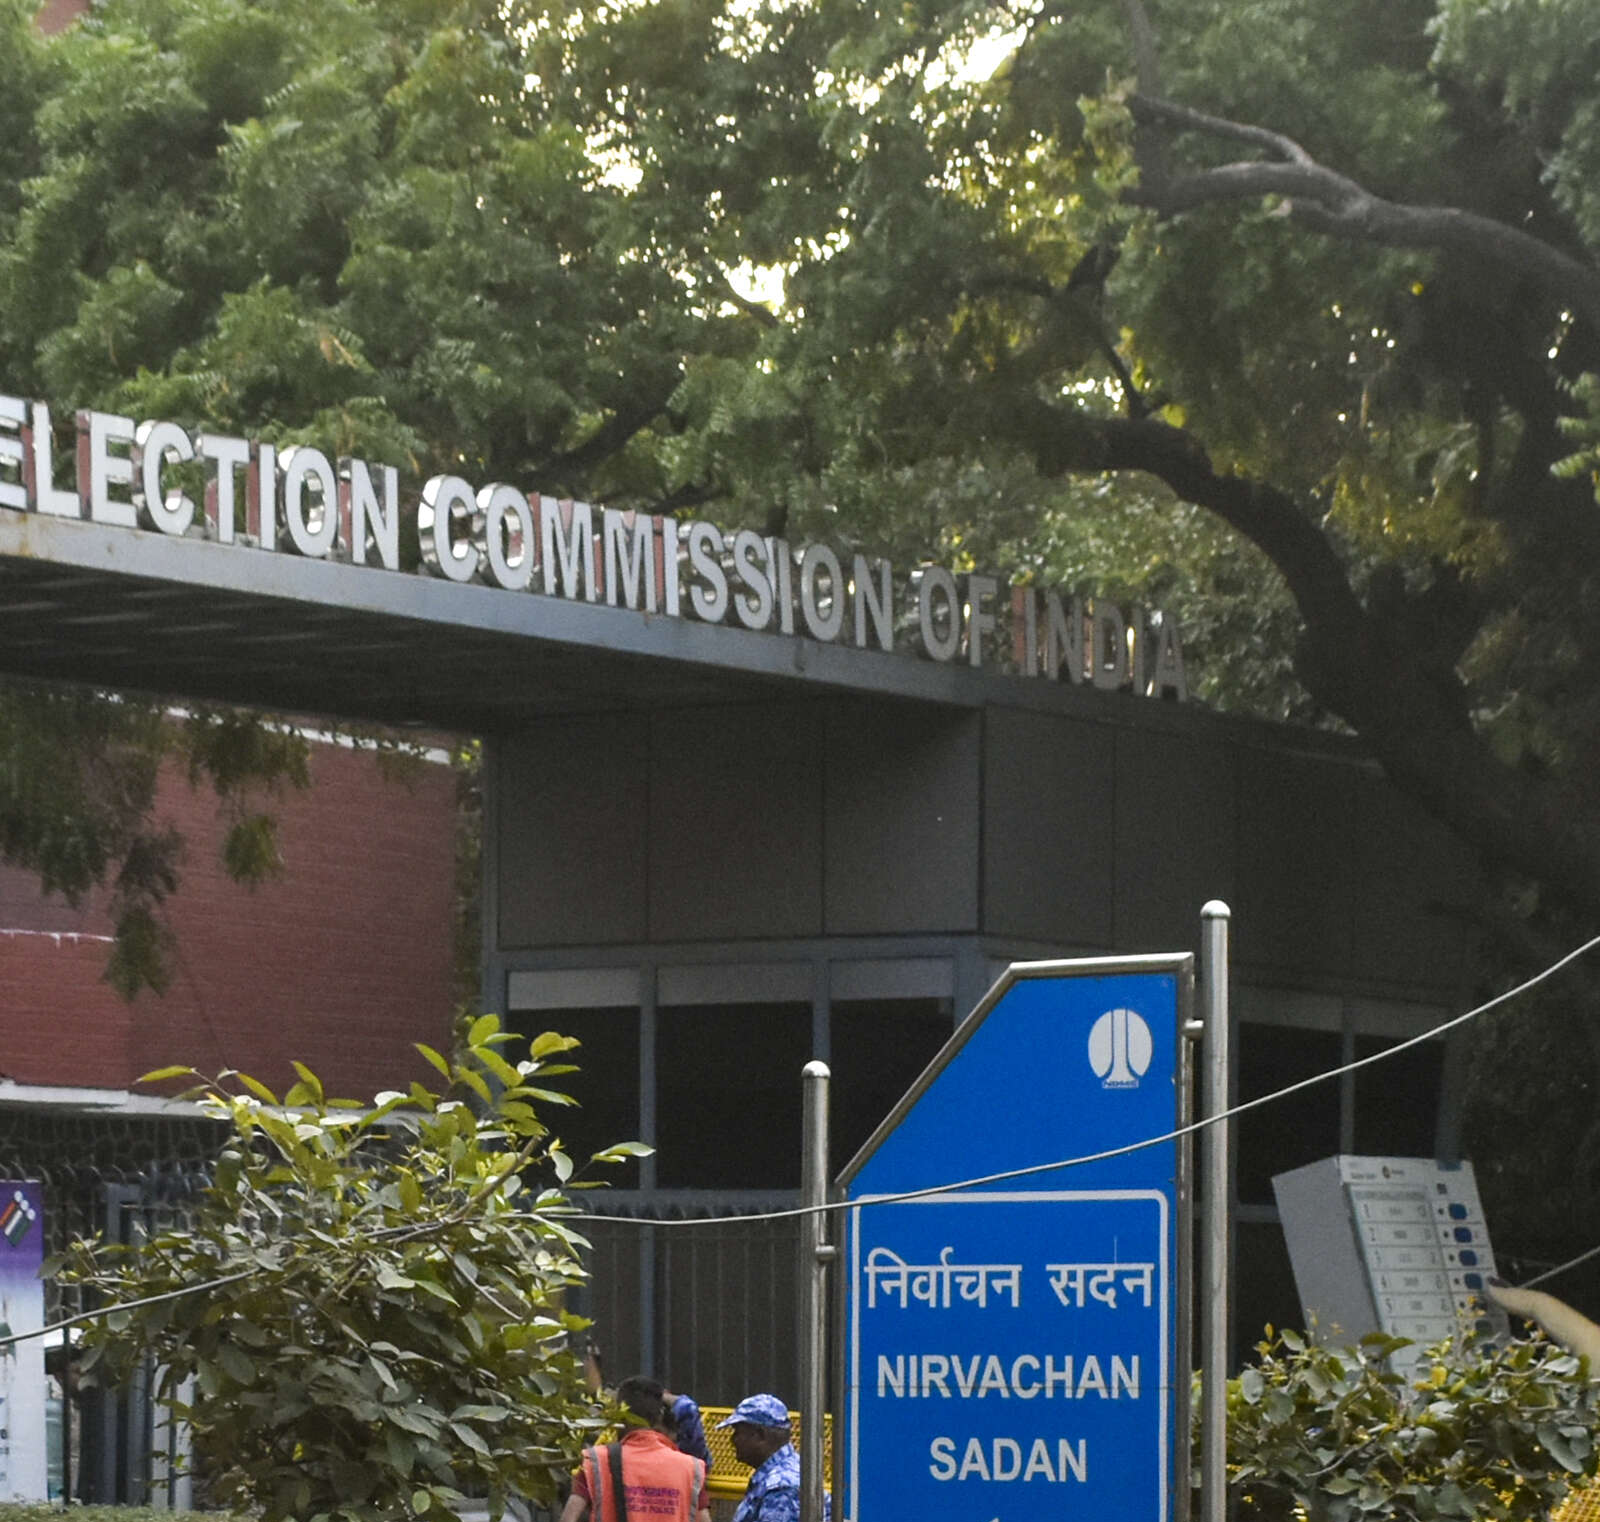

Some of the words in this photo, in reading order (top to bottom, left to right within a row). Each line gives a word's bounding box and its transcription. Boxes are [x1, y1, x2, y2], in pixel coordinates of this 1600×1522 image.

[418, 474, 895, 654] COMMISSION
[918, 568, 997, 667] OF
[1014, 582, 1189, 702] INDIA
[864, 1246, 1022, 1308] निर्वाचन
[1045, 1262, 1155, 1307] सदन
[877, 1354, 1141, 1400] NIRVACHAN
[928, 1436, 1088, 1483] SADAN
